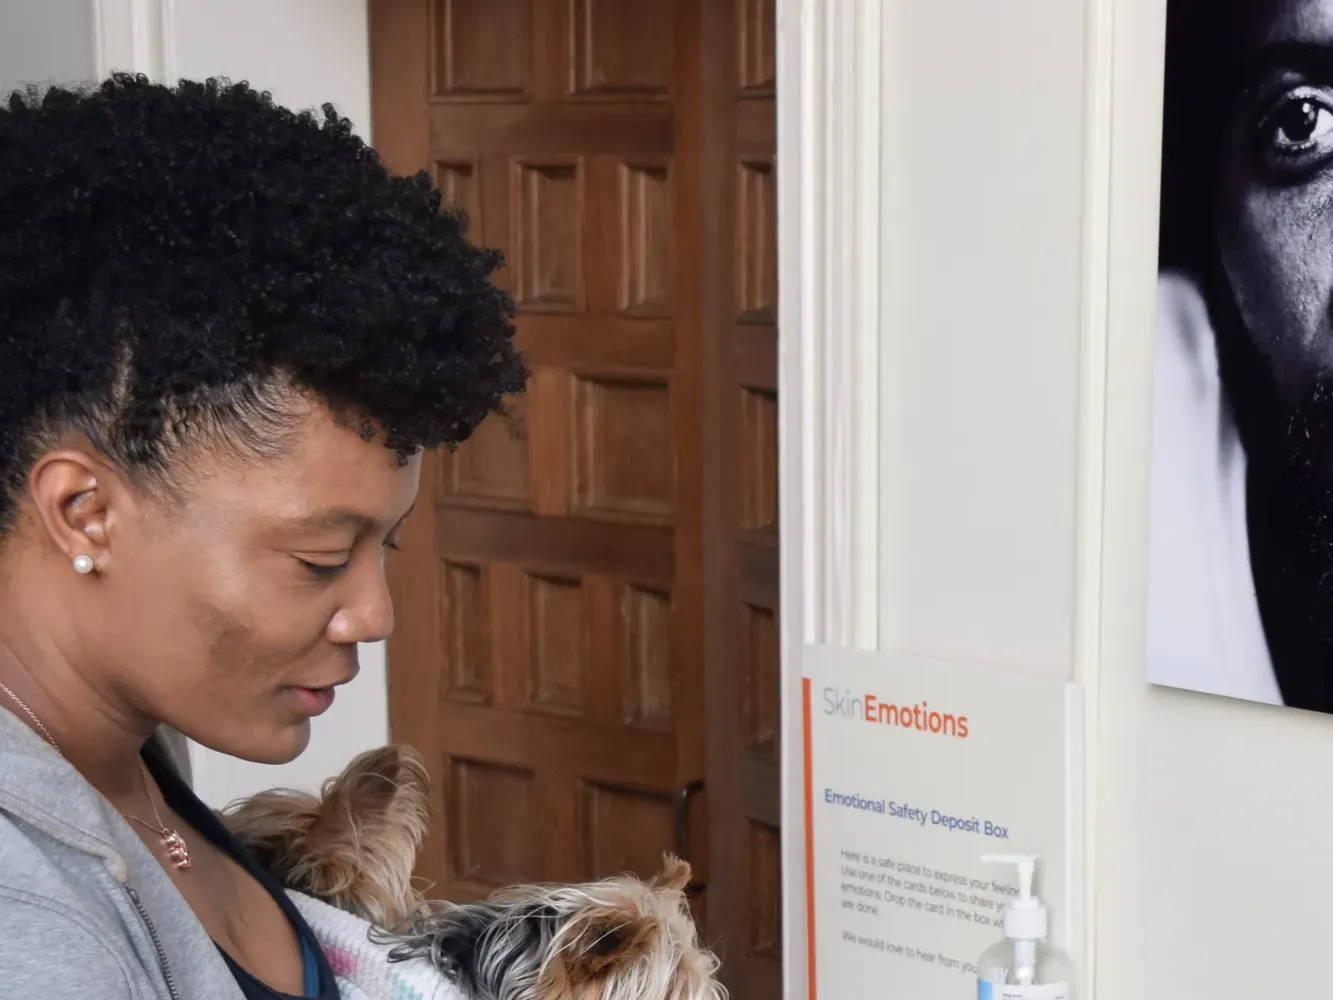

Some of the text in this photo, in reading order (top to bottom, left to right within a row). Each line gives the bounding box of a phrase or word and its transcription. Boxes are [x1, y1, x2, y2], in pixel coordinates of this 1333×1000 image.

[823, 685, 968, 738] SkinEmotions
[824, 788, 1010, 839] Emotional Safety Deposit Box
[841, 864, 859, 877] Use
[858, 869, 876, 880] one
[877, 871, 886, 884] of
[887, 875, 901, 889] the
[904, 879, 928, 893] cards
[929, 885, 956, 901] below
[958, 892, 969, 902] to
[969, 894, 994, 909] share
[878, 856, 895, 870] safe
[898, 861, 921, 876] place
[922, 867, 932, 877] to
[934, 870, 968, 887] express
[968, 878, 990, 890] your
[884, 891, 906, 906] Drop
[907, 895, 923, 909] the
[924, 900, 944, 915] card
[946, 906, 956, 918] in
[956, 908, 973, 922] the
[974, 912, 991, 926] box
[842, 929, 857, 944] We
[858, 935, 885, 951] would
[886, 940, 904, 955] love
[905, 945, 916, 958] to
[916, 949, 937, 963] hear
[938, 953, 960, 968] from
